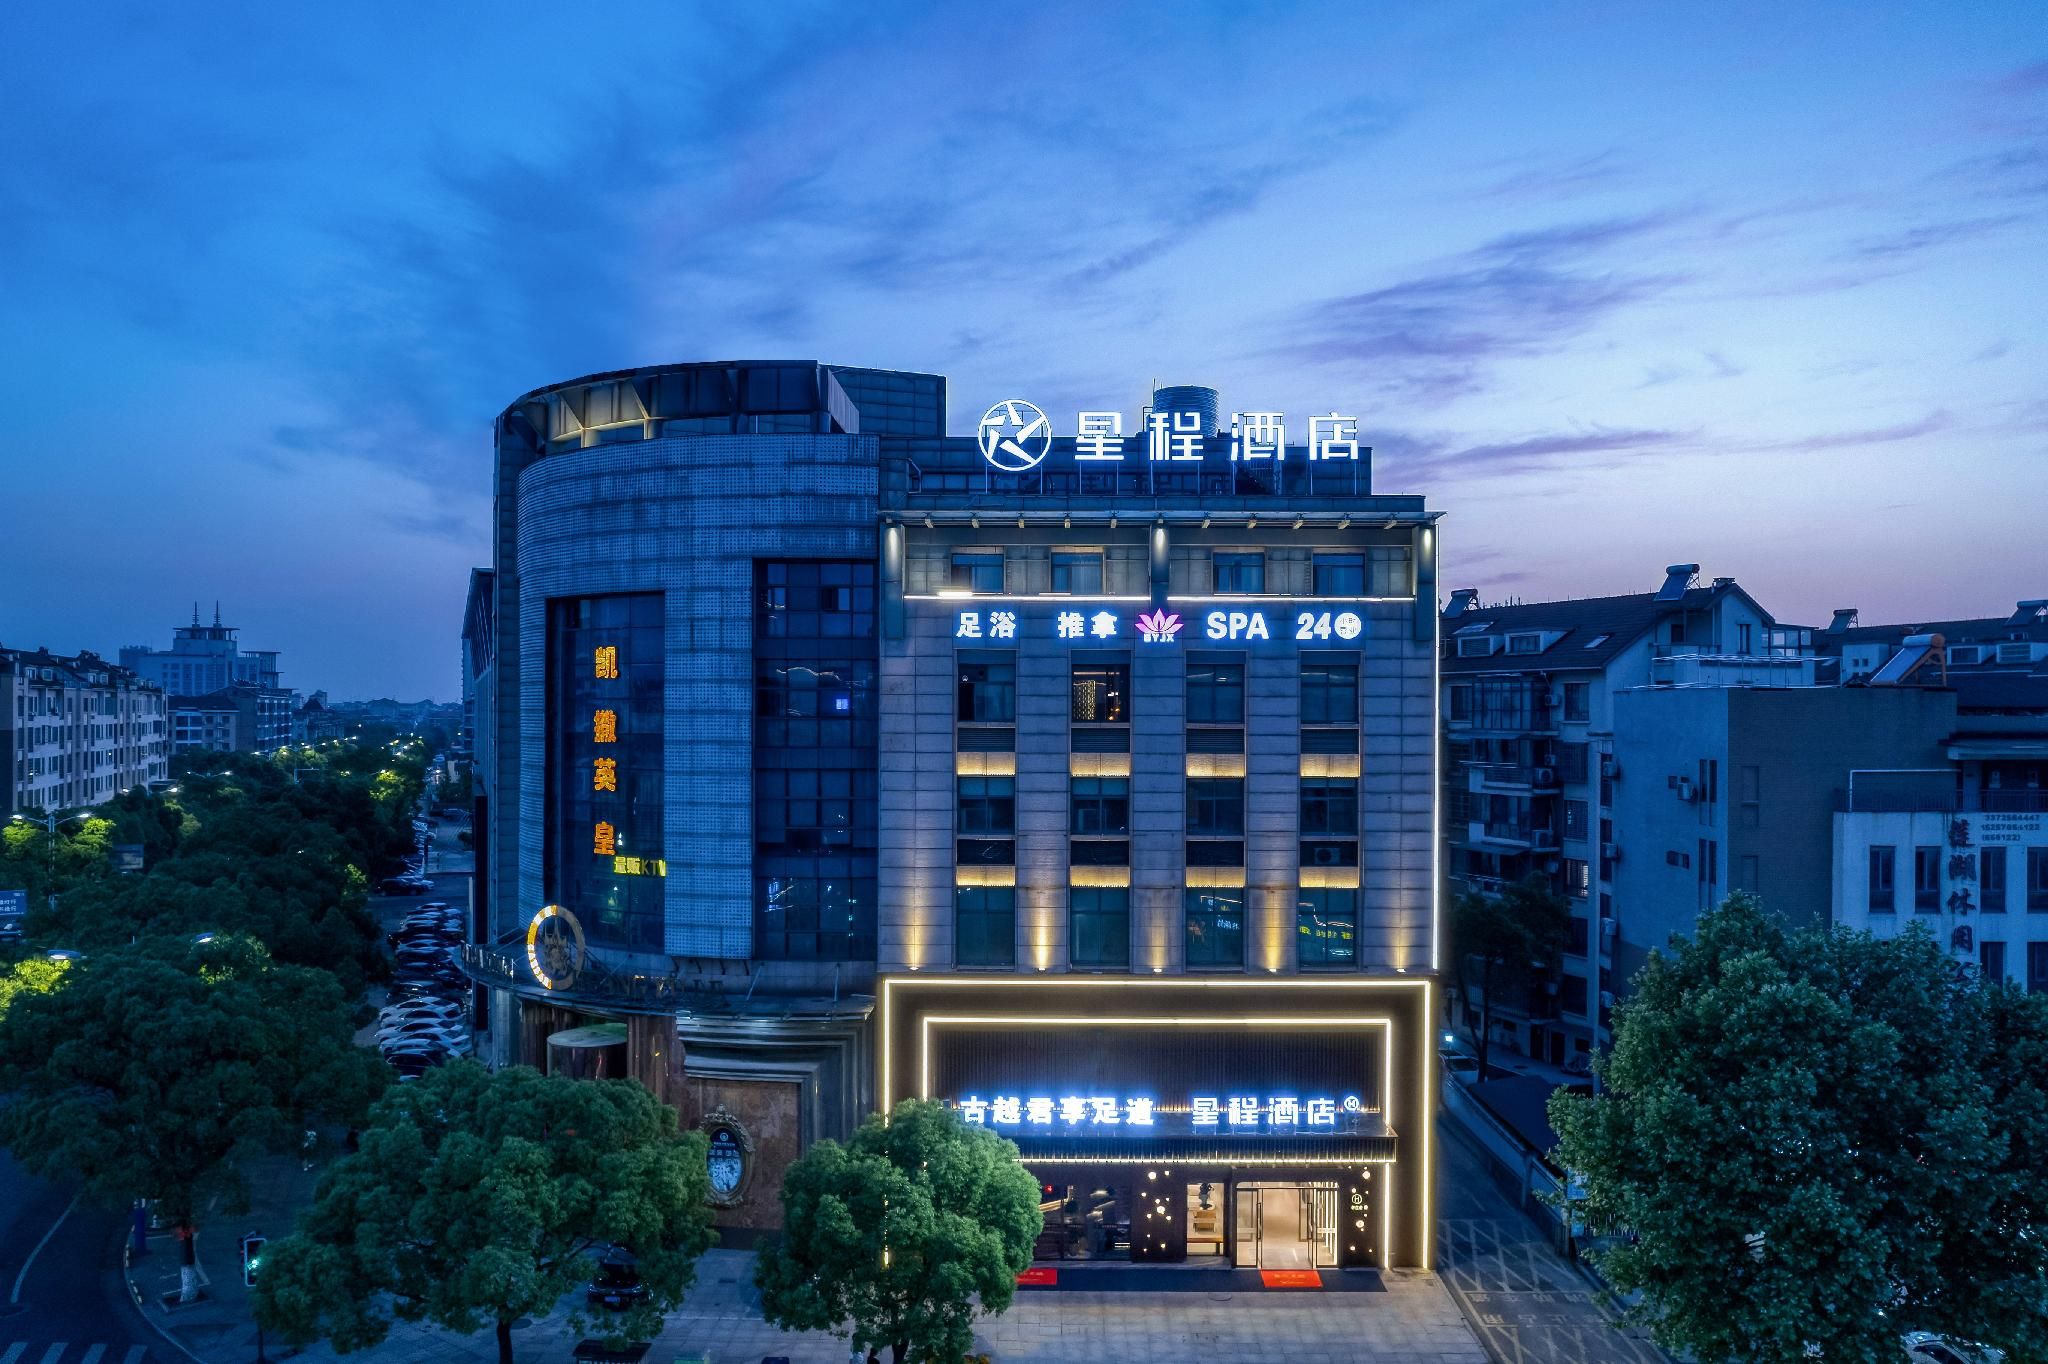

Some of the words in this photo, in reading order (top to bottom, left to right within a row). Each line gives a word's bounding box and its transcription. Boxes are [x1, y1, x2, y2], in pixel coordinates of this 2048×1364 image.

[1075, 411, 1359, 461] 星程酒店
[956, 612, 1017, 639] 足浴
[1057, 611, 1119, 639] 推拿
[1207, 612, 1269, 640] SPA
[1296, 612, 1332, 640] 24
[613, 856, 667, 877] 量贩KTV
[960, 1095, 1154, 1125] 古越君享足道
[1191, 1097, 1335, 1125] 星程酒店
